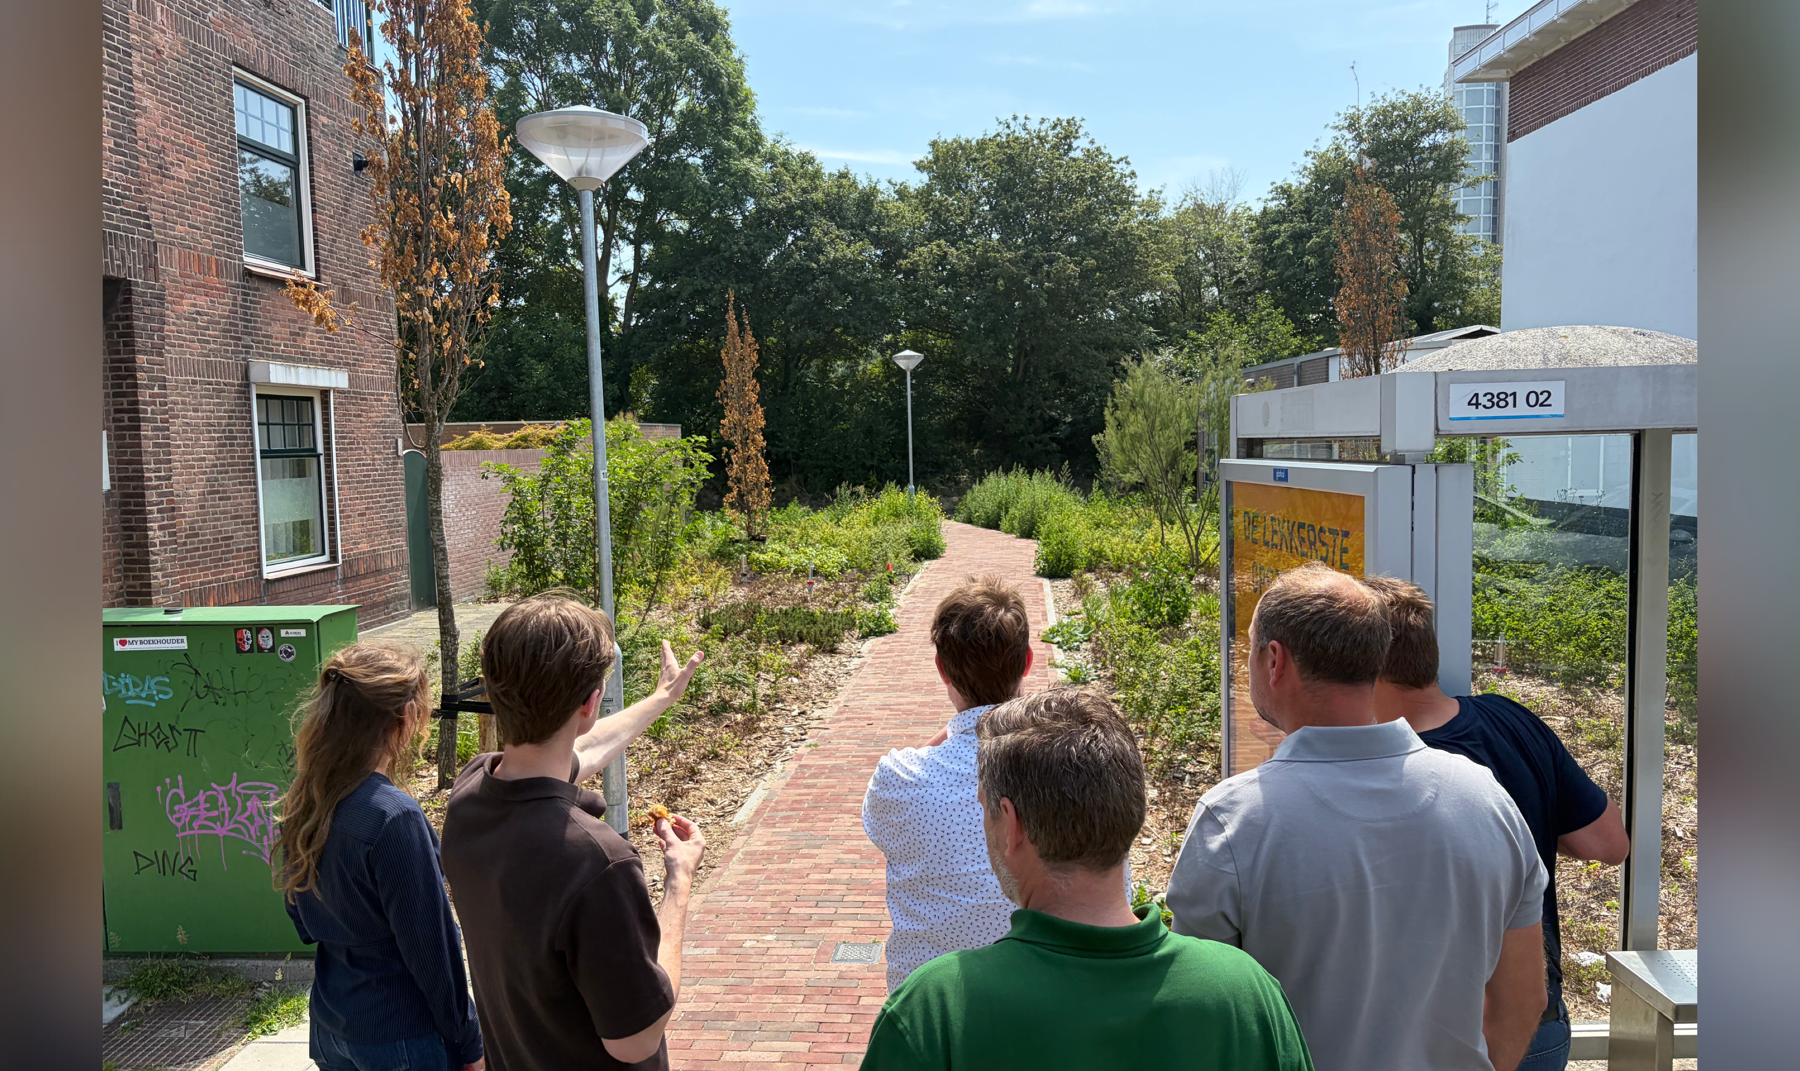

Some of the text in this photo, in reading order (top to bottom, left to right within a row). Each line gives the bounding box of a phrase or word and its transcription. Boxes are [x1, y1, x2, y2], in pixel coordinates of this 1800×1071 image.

[1467, 390, 1552, 410] 4381 02
[1243, 510, 1350, 571] DE LEKKERSTE
[133, 850, 198, 881] DING
